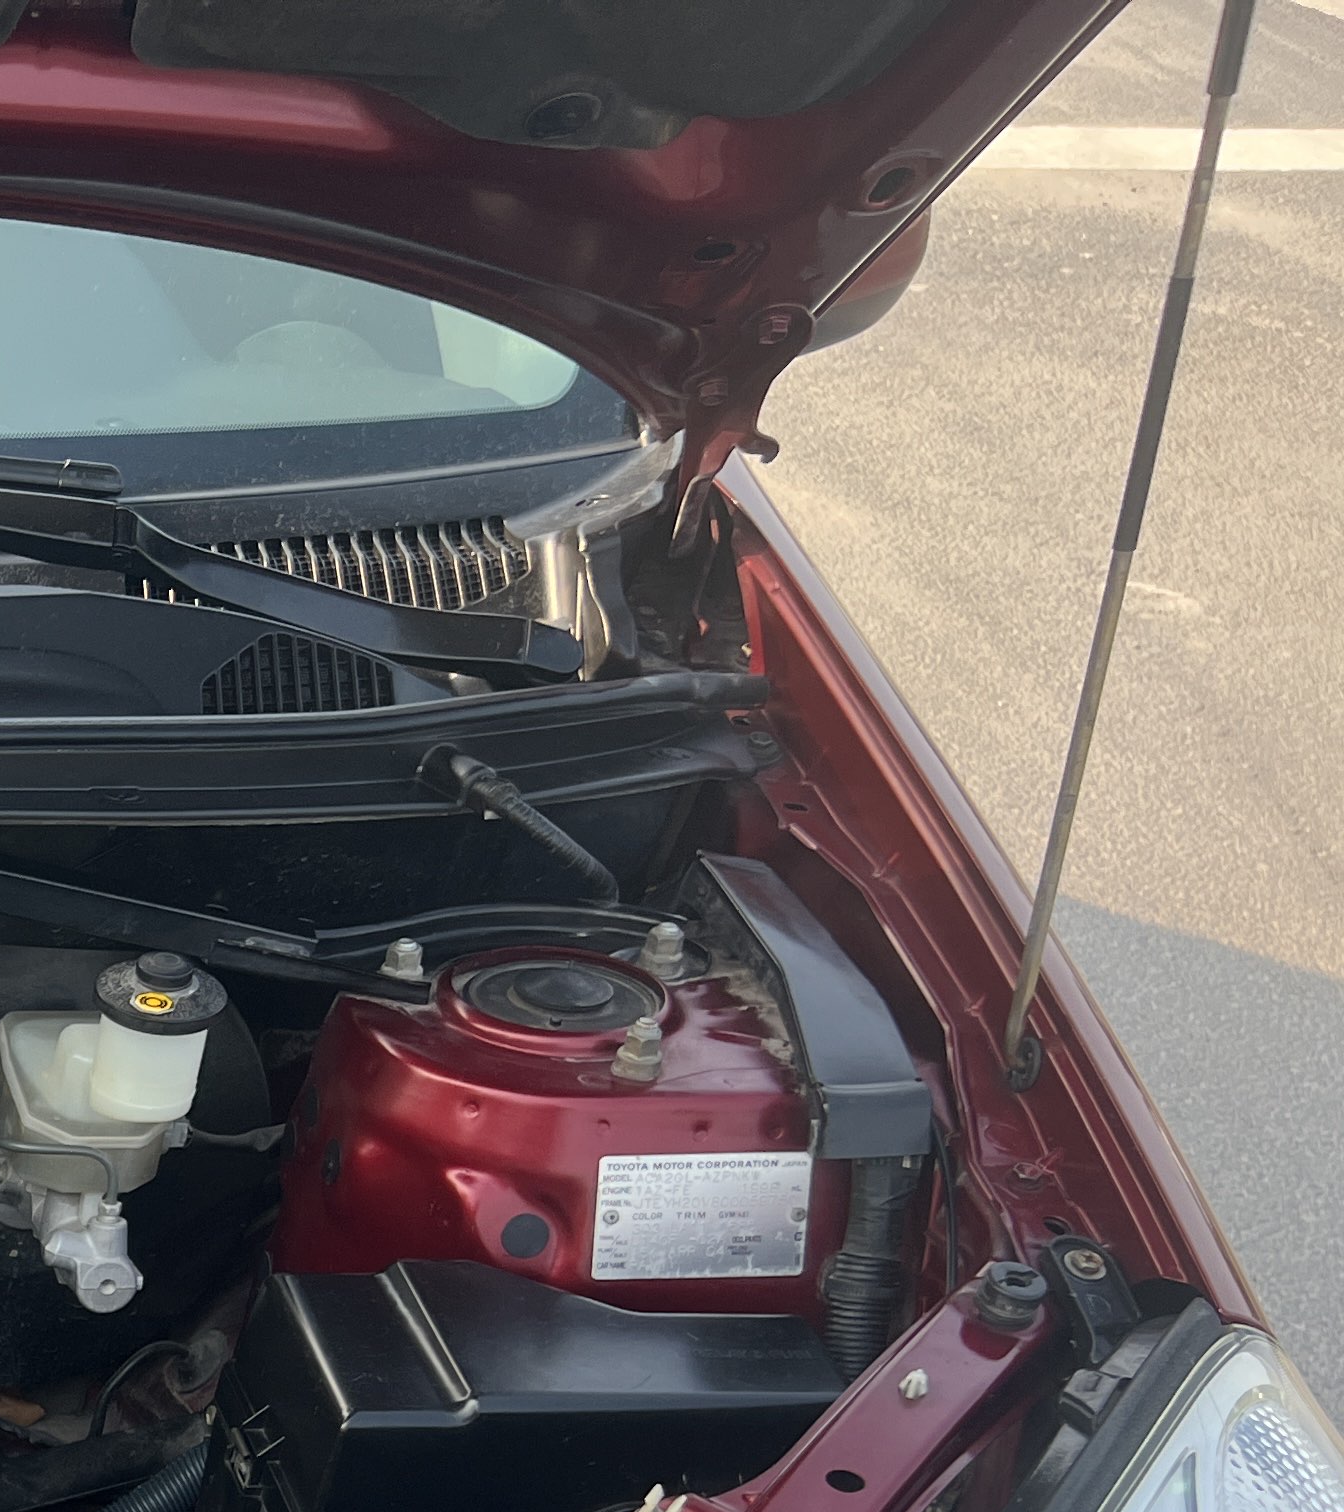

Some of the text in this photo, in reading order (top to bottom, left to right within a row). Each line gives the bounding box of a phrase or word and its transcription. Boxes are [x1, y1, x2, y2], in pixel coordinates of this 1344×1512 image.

[607, 1163, 648, 1171] TOYOTA
[653, 1162, 692, 1170] MOTOR
[697, 1160, 779, 1169] CORPORATION
[603, 1174, 632, 1182] MODEL
[632, 1212, 662, 1220] COLOR
